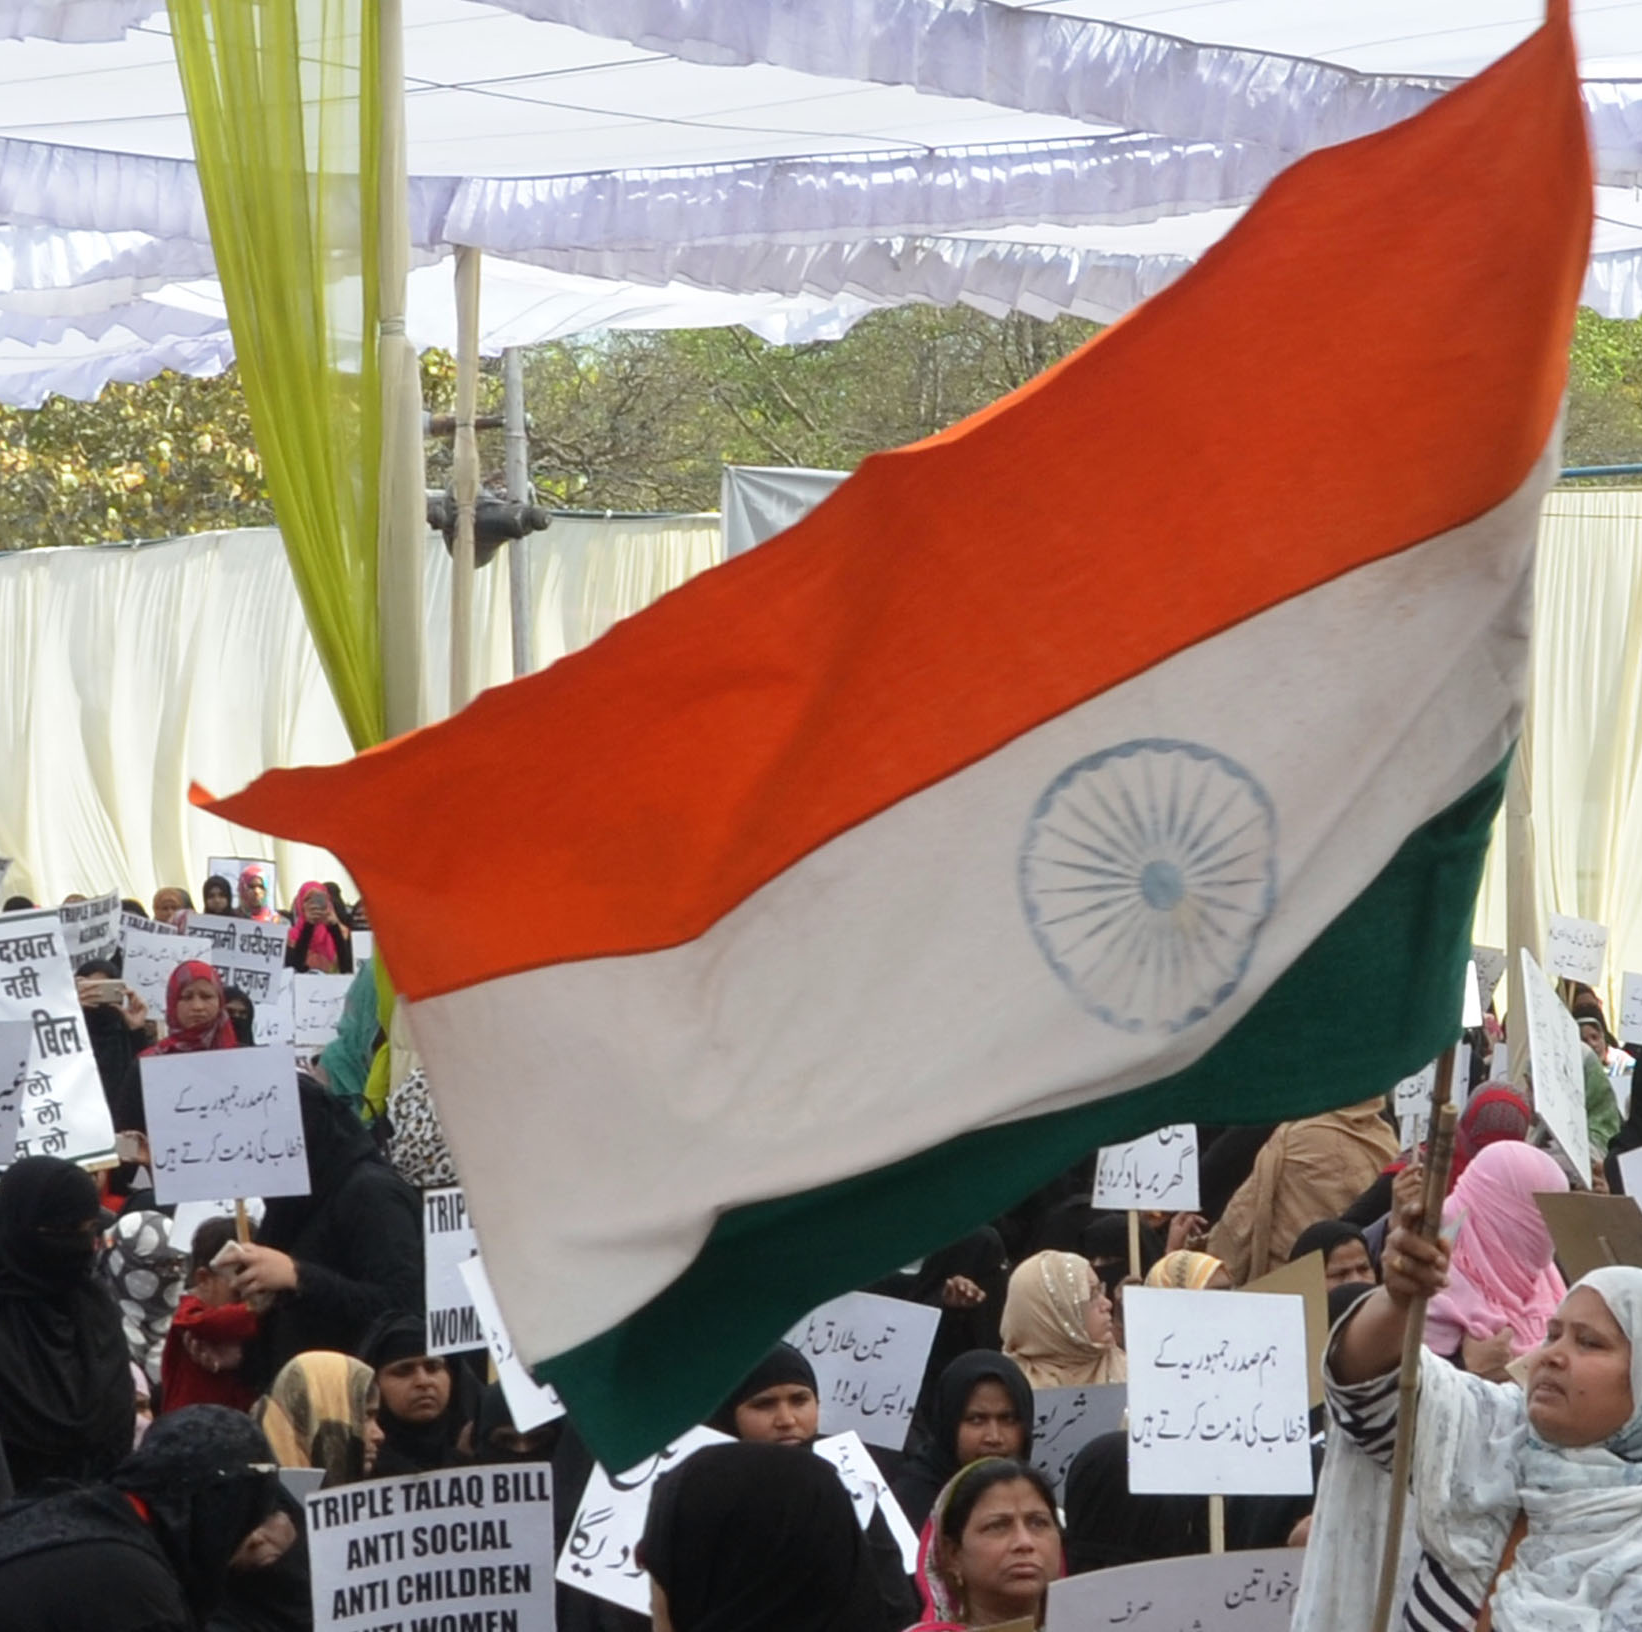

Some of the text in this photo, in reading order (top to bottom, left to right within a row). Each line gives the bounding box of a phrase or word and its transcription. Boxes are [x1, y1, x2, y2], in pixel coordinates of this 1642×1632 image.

[31, 1009, 83, 1059] बिल
[34, 1098, 63, 1127] लो
[308, 1471, 550, 1531] TRIPLE TALAQ BILL
[347, 1519, 512, 1570] ANTI SOCIAL
[332, 1563, 531, 1620] ANTI CHILDREN
